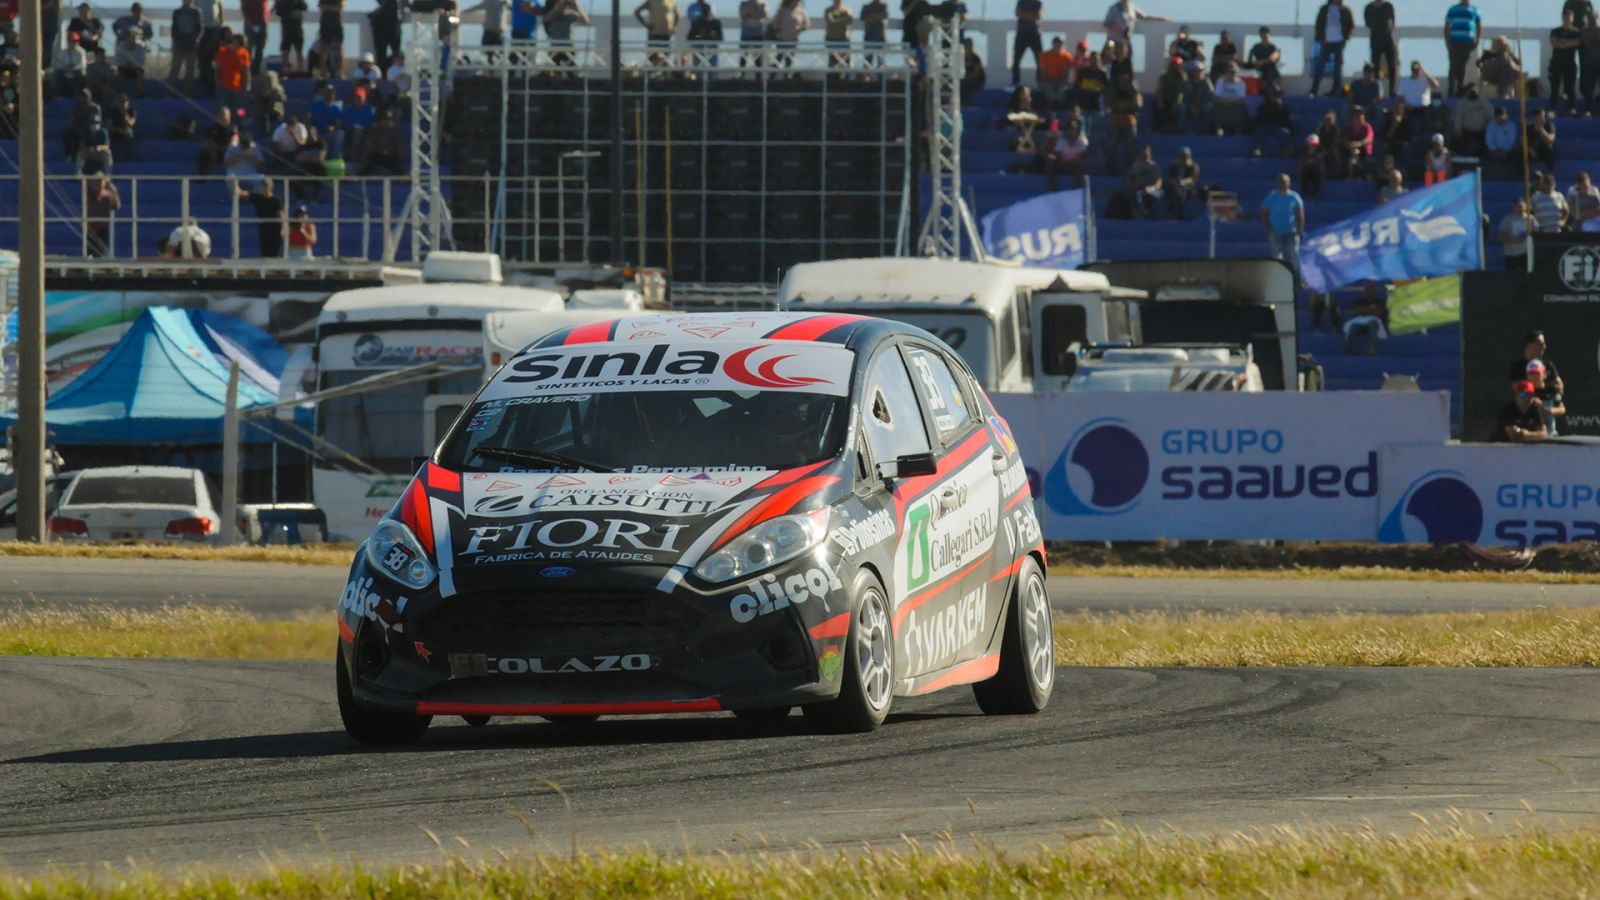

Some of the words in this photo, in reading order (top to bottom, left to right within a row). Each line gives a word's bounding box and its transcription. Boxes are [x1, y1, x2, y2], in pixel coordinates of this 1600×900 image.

[535, 380, 624, 391] SINTETICOS
[643, 378, 692, 386] LACAS
[505, 394, 593, 407] CRAVERO
[1161, 429, 1284, 454] GRUPO
[560, 488, 694, 499] ORGANIZACION
[458, 518, 690, 554] FIORI
[931, 519, 973, 571] Callegari
[383, 546, 409, 571] 38
[474, 552, 545, 564] FABRICA
[549, 551, 572, 559] DE
[575, 550, 654, 562] ATAUDES
[923, 582, 988, 669] VARKEM
